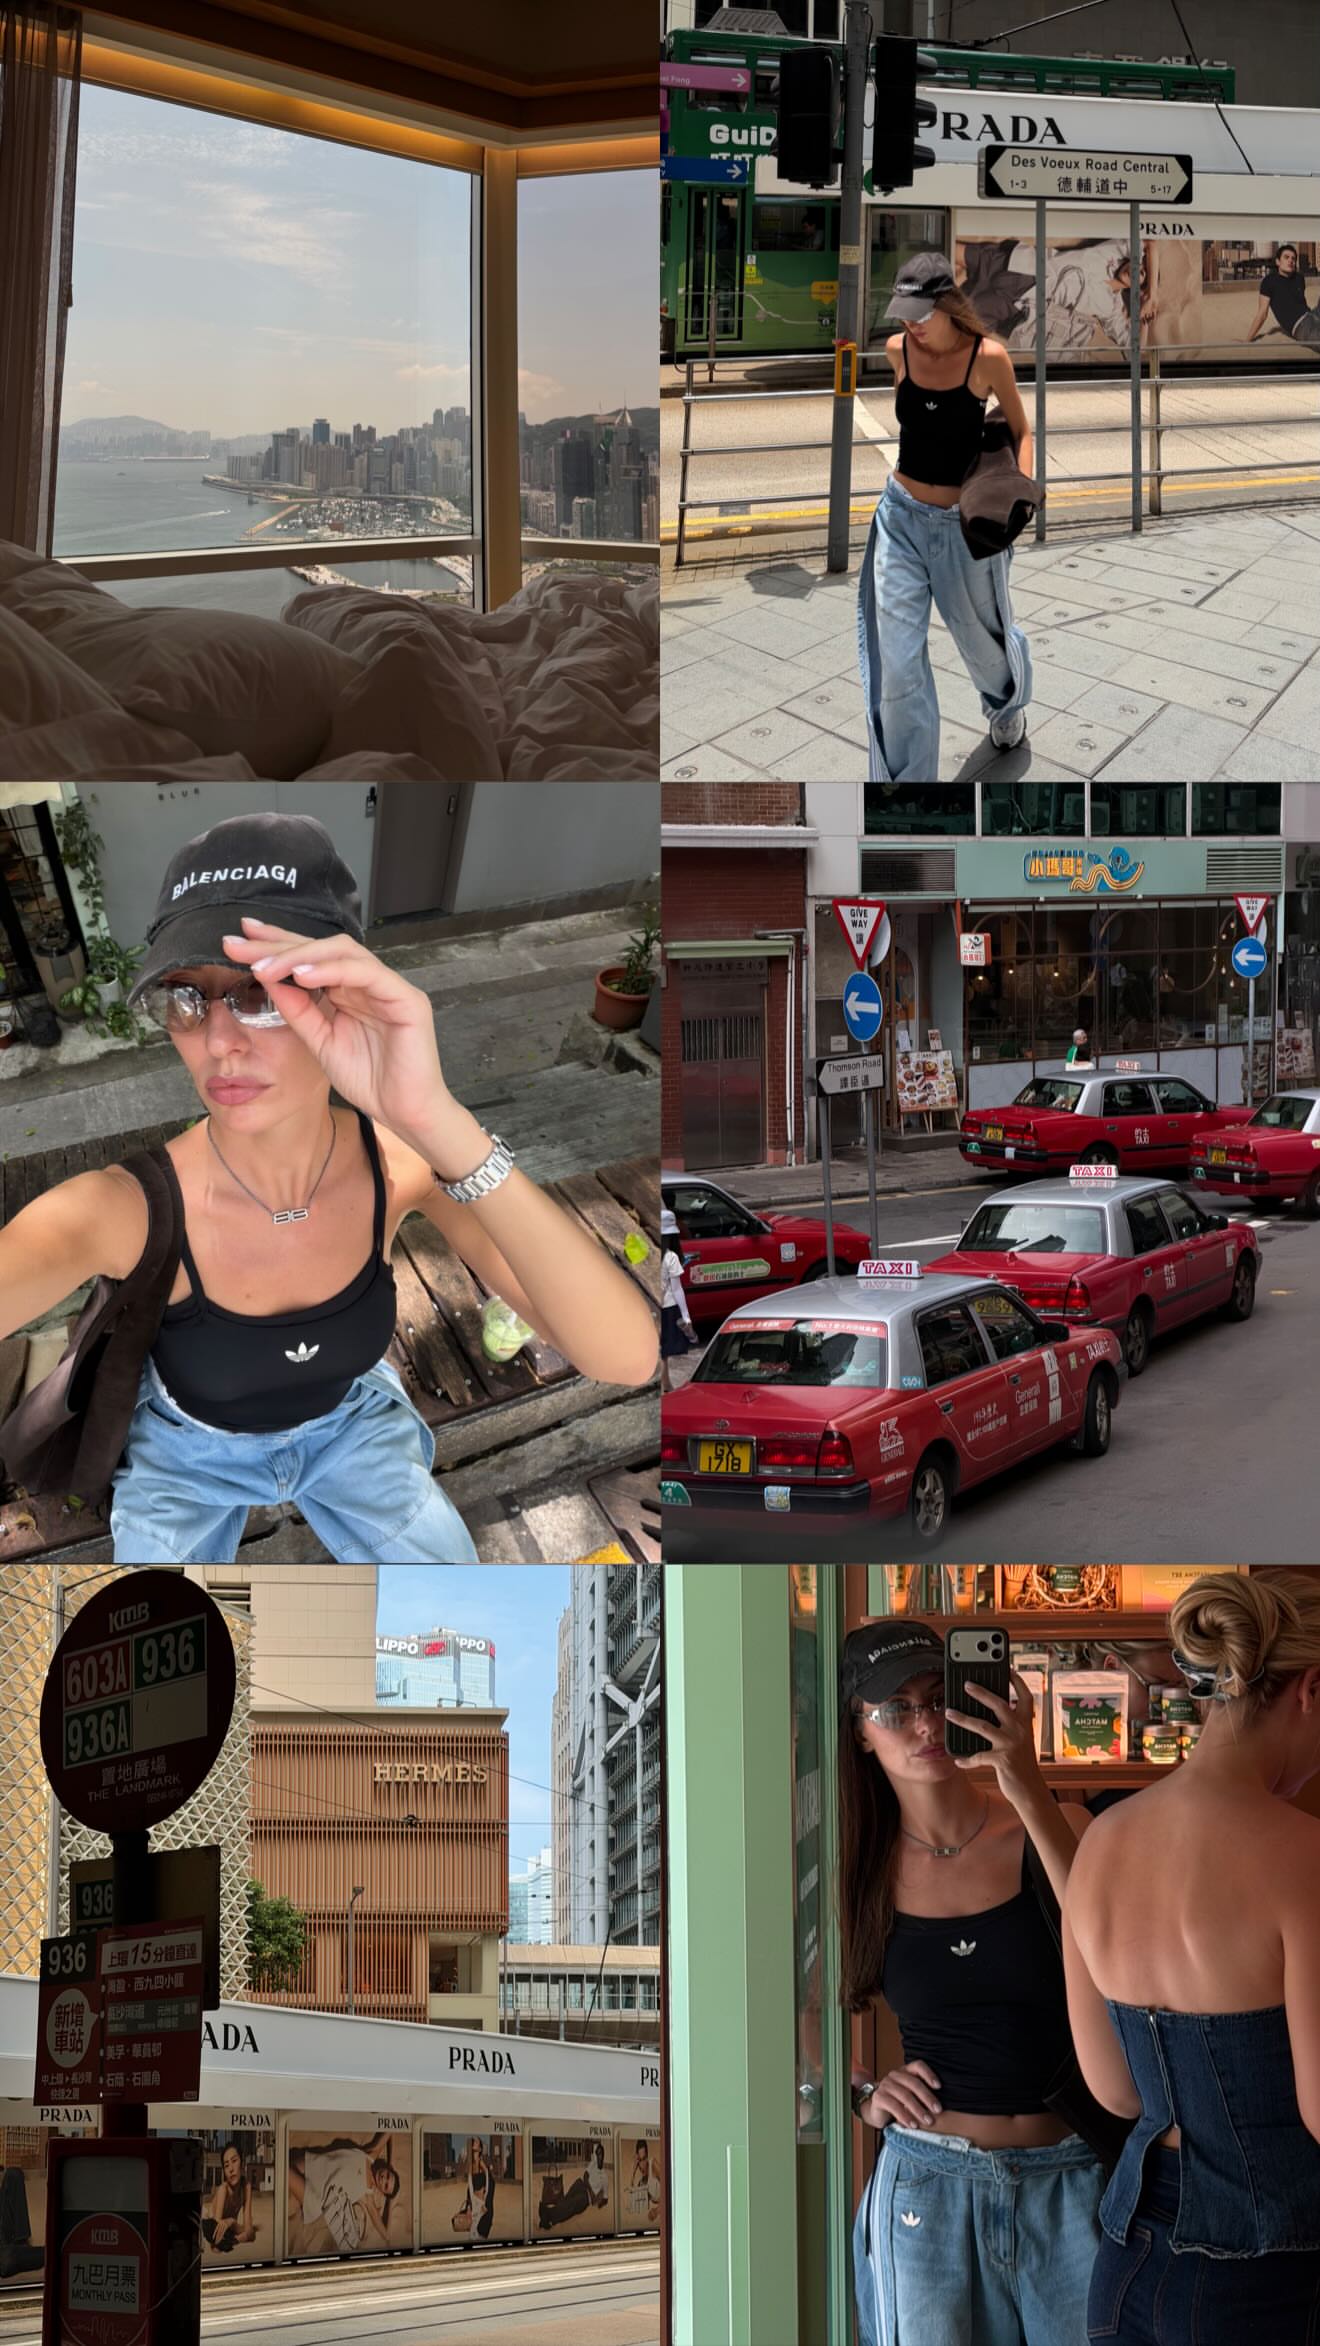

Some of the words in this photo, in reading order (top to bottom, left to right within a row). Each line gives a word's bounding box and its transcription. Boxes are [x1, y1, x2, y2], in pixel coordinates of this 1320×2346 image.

[1011, 155, 1036, 168] Des
[1040, 156, 1081, 169] Voeux
[1086, 158, 1118, 171] Road
[1124, 160, 1170, 174] Central
[1010, 179, 1027, 189] 1-3
[1058, 177, 1128, 194] 德輔道中
[1150, 184, 1172, 194] 5-17
[172, 865, 297, 900] BALENCIAGA
[850, 908, 869, 918] GIVE
[851, 919, 868, 929] WAY
[827, 1061, 861, 1073] Thomson
[863, 1058, 882, 1069] Road
[1073, 1166, 1113, 1177] TAXI
[863, 1262, 913, 1275] TAXI
[715, 1441, 735, 1457] GX
[708, 1456, 741, 1472] 1718
[376, 1636, 418, 1655] LIPPO
[142, 1628, 195, 1682] 936
[67, 1646, 128, 1703] 603A
[67, 1705, 129, 1761] 936A
[101, 1754, 167, 1787] 置地廣場
[88, 1788, 110, 1804] THE
[115, 1774, 181, 1797] LANDMARK
[48, 1941, 87, 1977] 936
[55, 2002, 84, 2028] 新增
[55, 2029, 84, 2055] 車站
[448, 2046, 516, 2075] PRADA
[40, 2107, 92, 2122] PRADA
[231, 2113, 272, 2127] PRADA
[377, 2117, 410, 2129] PRADA
[493, 2121, 521, 2133] PRADA
[588, 2126, 612, 2137] PRADA
[73, 2264, 136, 2287] 九巴月票
[72, 2289, 113, 2302] MONTHLY
[114, 2291, 137, 2304] PASS
